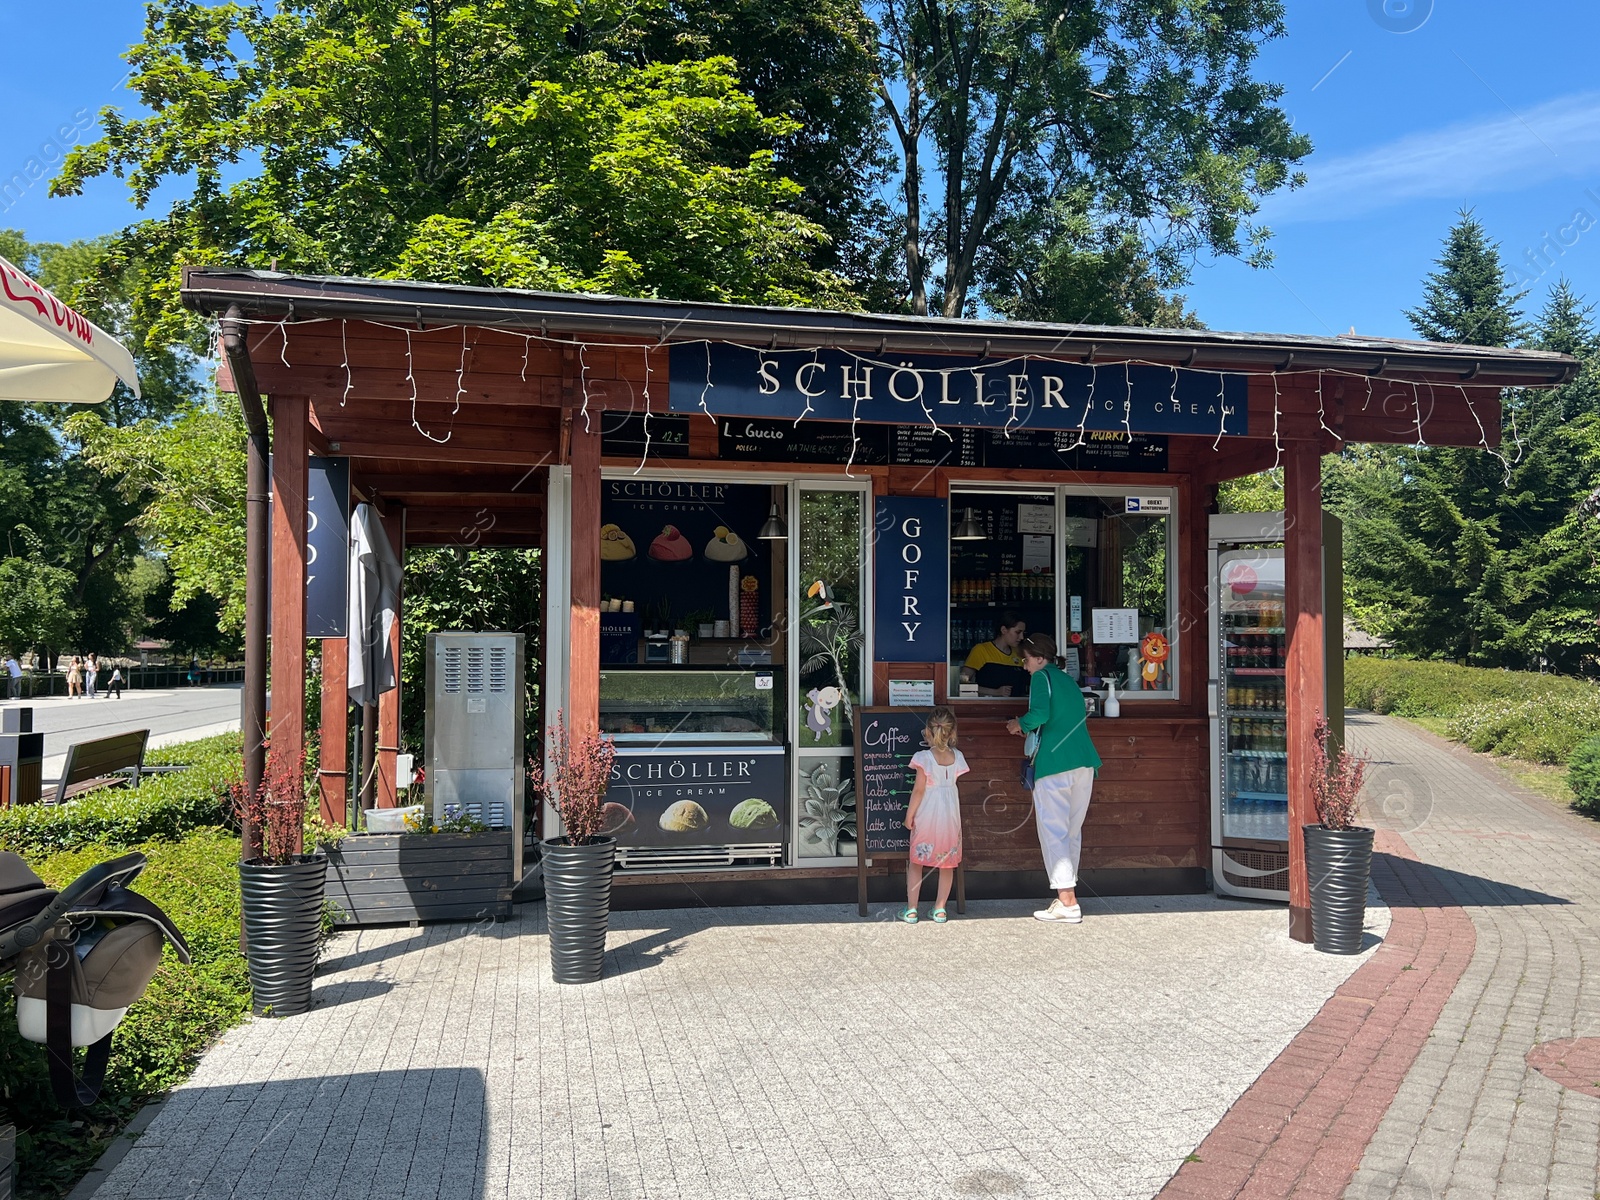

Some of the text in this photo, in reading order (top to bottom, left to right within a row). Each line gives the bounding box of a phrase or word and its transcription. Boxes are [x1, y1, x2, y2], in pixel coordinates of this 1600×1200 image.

[758, 361, 1236, 416] SCHÖLLER ICE CREAM
[1091, 431, 1124, 441] RURKI
[901, 517, 922, 642] GOFRY
[864, 720, 910, 752] Coffee
[638, 788, 726, 797] ICE CREAM
[889, 819, 902, 830] ice
[865, 837, 885, 849] tonic
